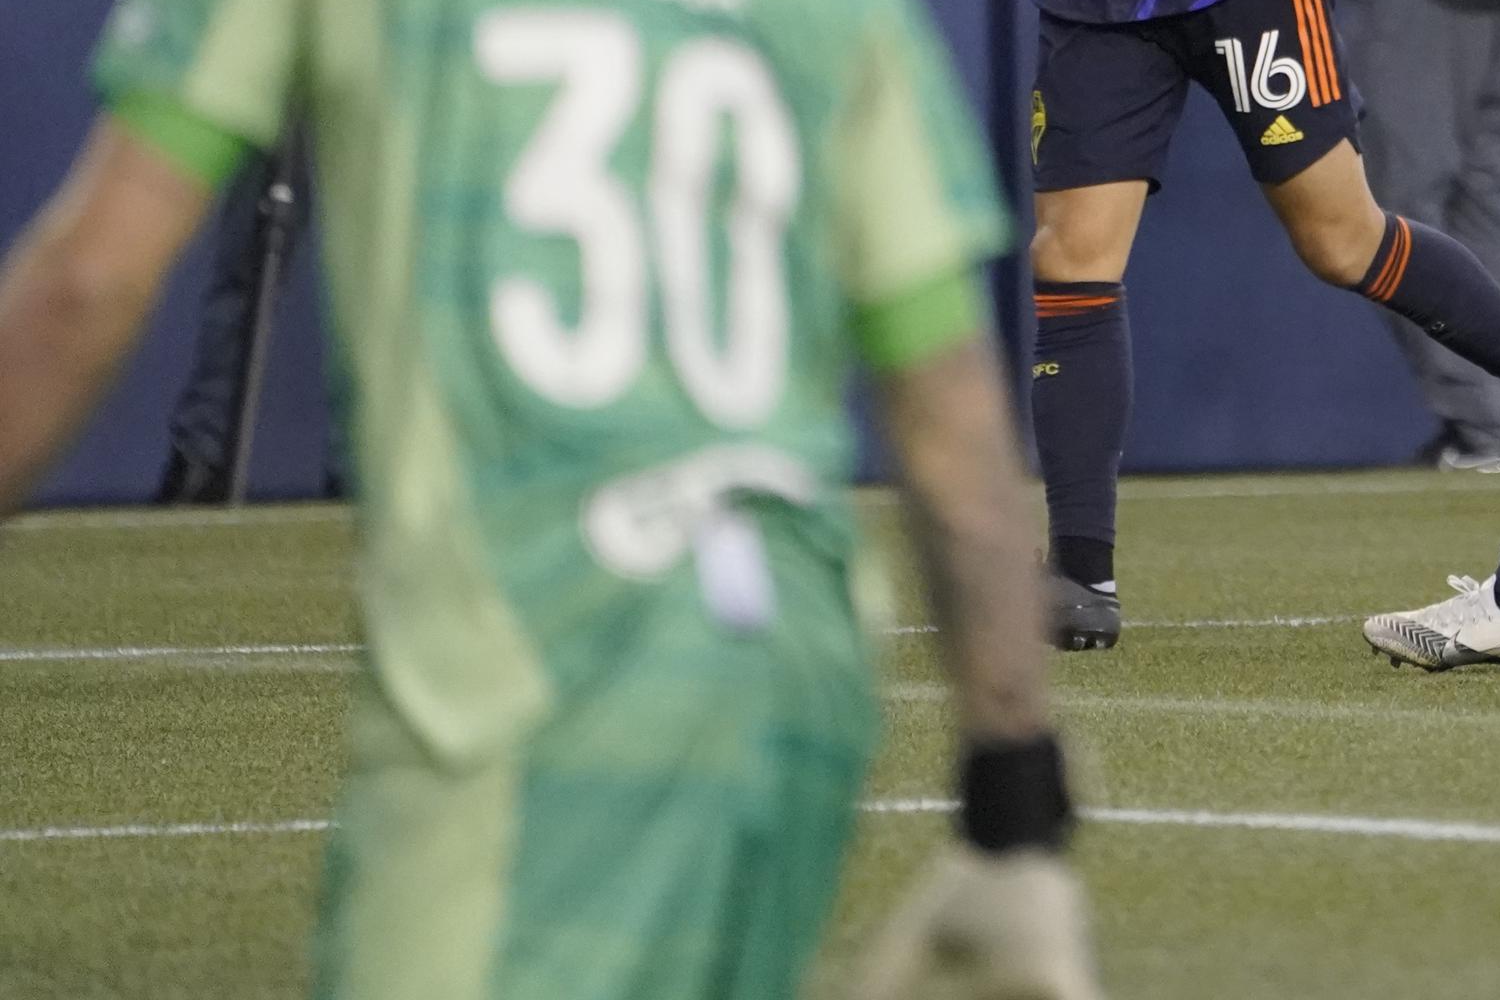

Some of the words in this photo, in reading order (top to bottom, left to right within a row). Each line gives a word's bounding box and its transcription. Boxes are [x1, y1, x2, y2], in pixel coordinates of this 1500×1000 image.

[1214, 29, 1306, 113] 16
[1260, 130, 1304, 146] adidas
[474, 6, 802, 428] 30
